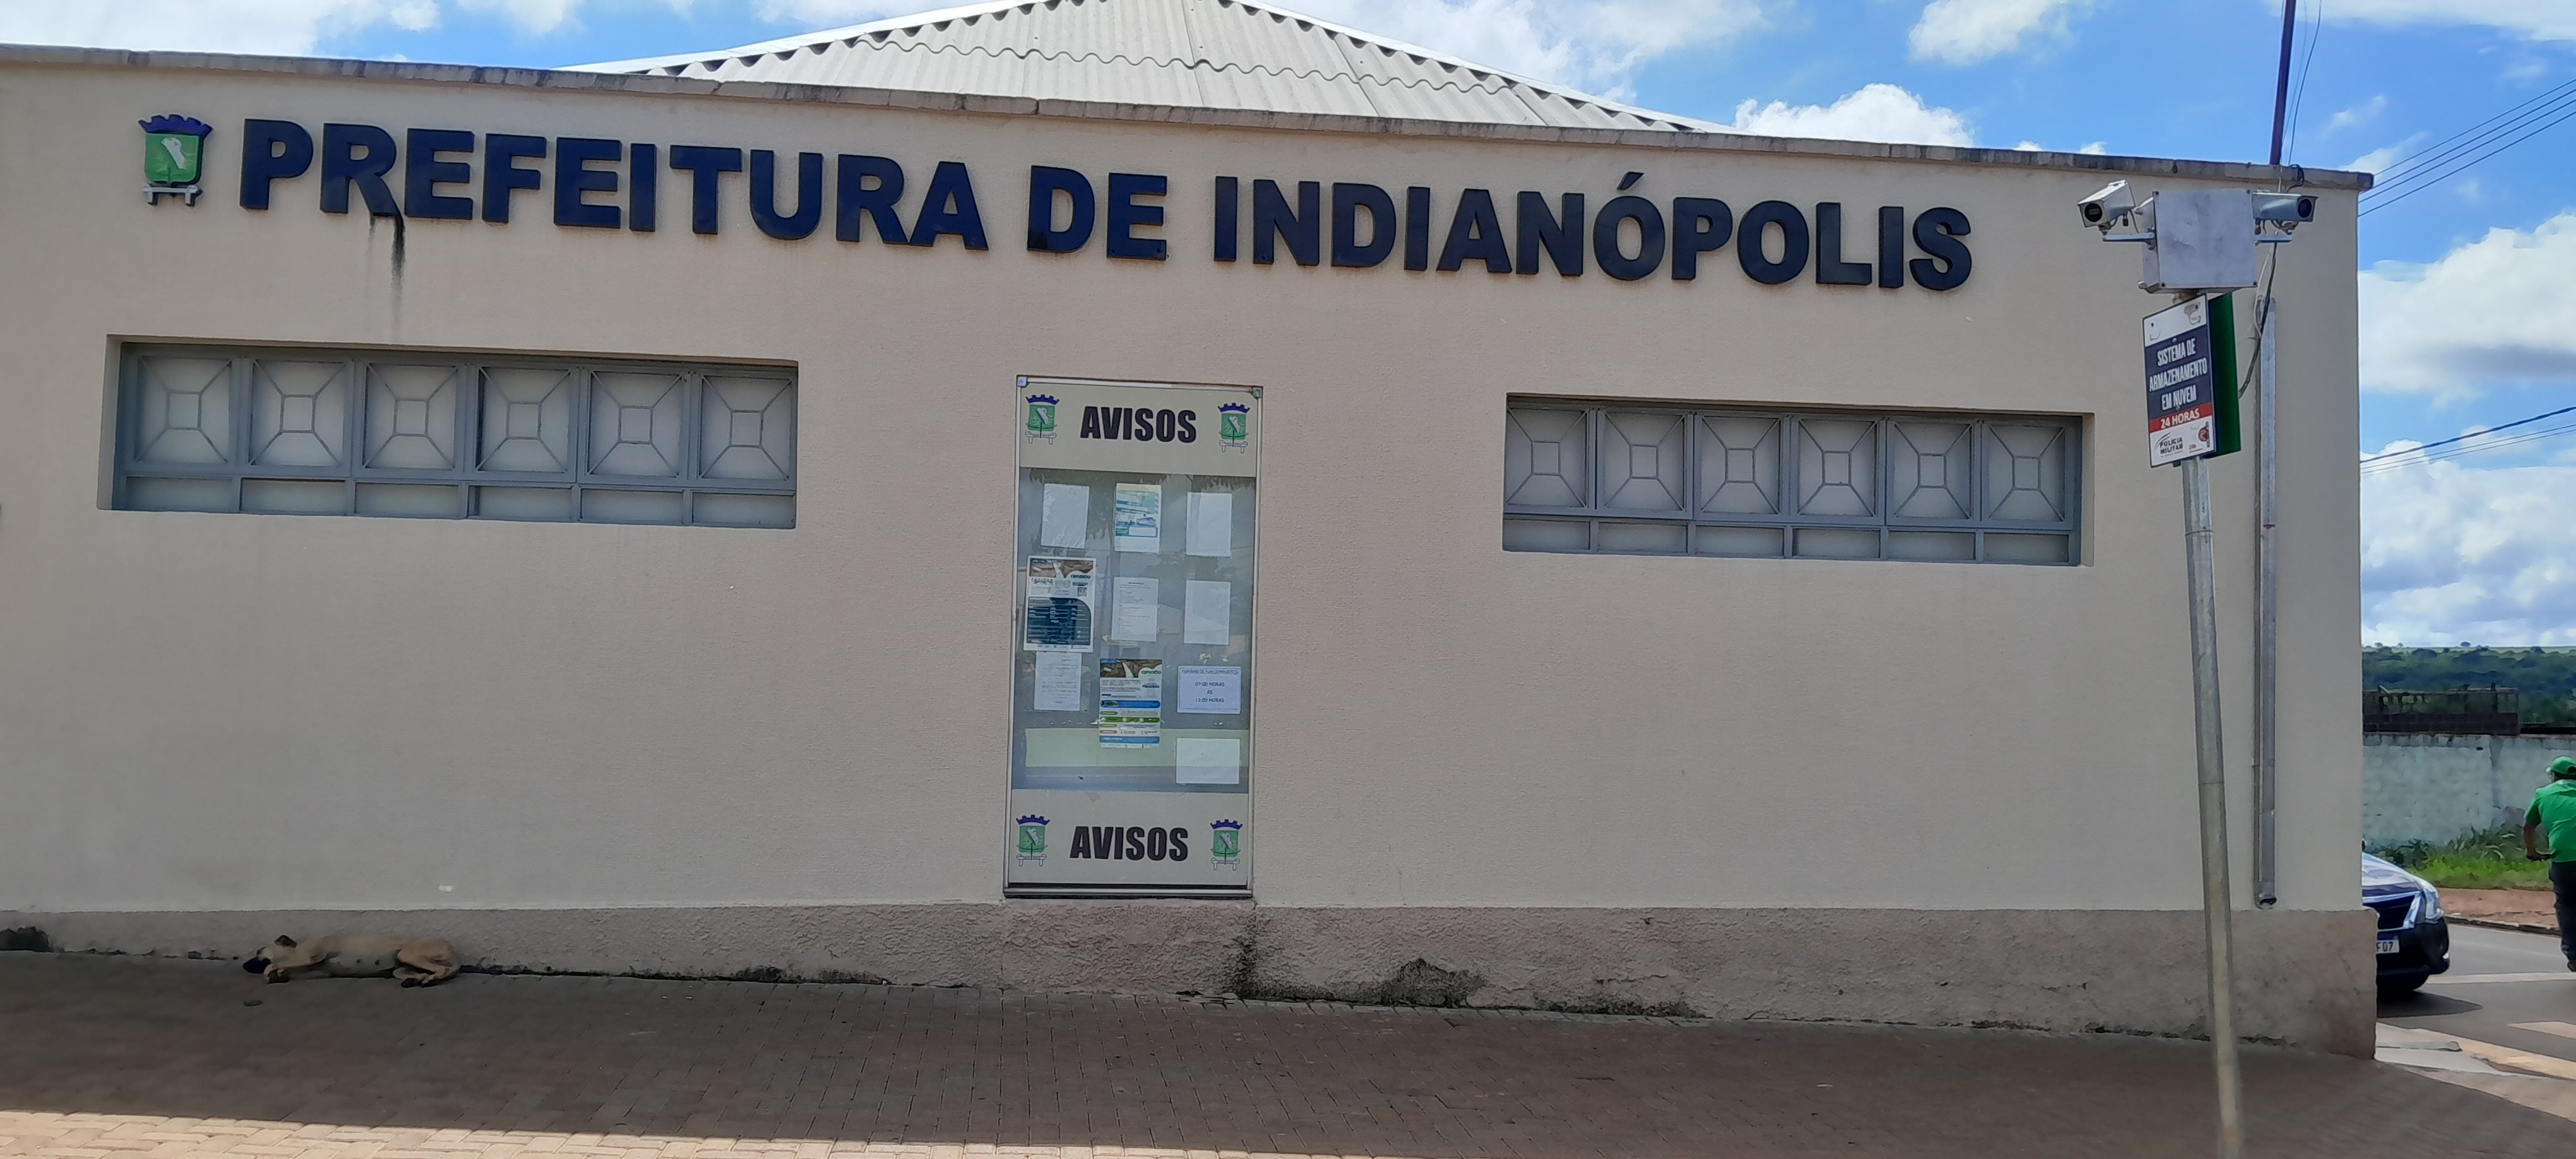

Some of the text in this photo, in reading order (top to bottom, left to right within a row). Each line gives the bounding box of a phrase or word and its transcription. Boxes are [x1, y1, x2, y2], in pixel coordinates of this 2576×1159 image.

[239, 118, 1972, 292] PREFEITURA DE INDIANÓPOLIS
[2157, 337, 2197, 367] SISTEMA DE
[2149, 357, 2208, 392] ARMAZENAMENTO
[2161, 384, 2197, 411] EM NUVEM
[1080, 406, 1197, 444] AVISOS
[2160, 407, 2200, 429] 24 HORAS
[2160, 443, 2183, 455] MILITAR
[1070, 826, 1188, 862] AVISOS
